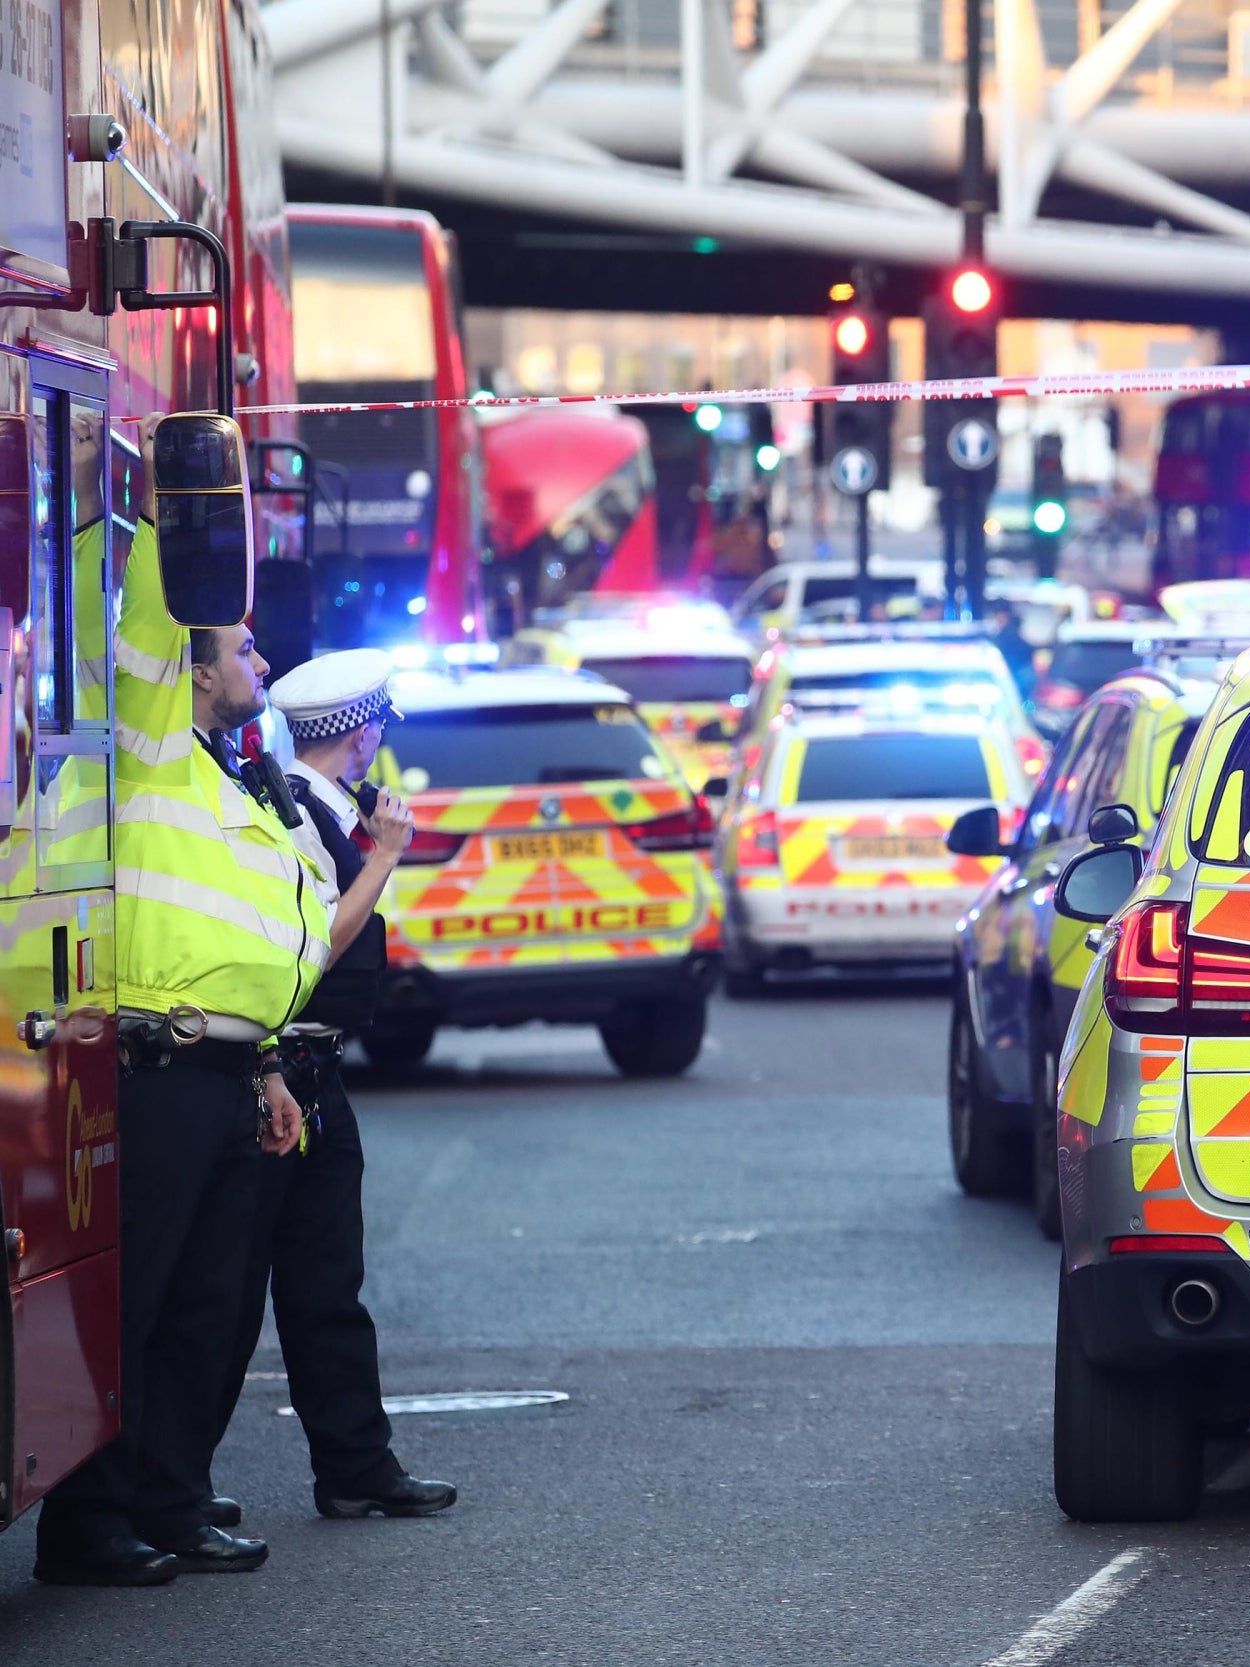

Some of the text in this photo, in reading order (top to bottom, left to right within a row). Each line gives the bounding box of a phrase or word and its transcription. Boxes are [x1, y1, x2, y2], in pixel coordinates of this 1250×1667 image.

[431, 903, 671, 939] POLICE
[787, 901, 965, 917] POLIC
[66, 1078, 92, 1233] Go
